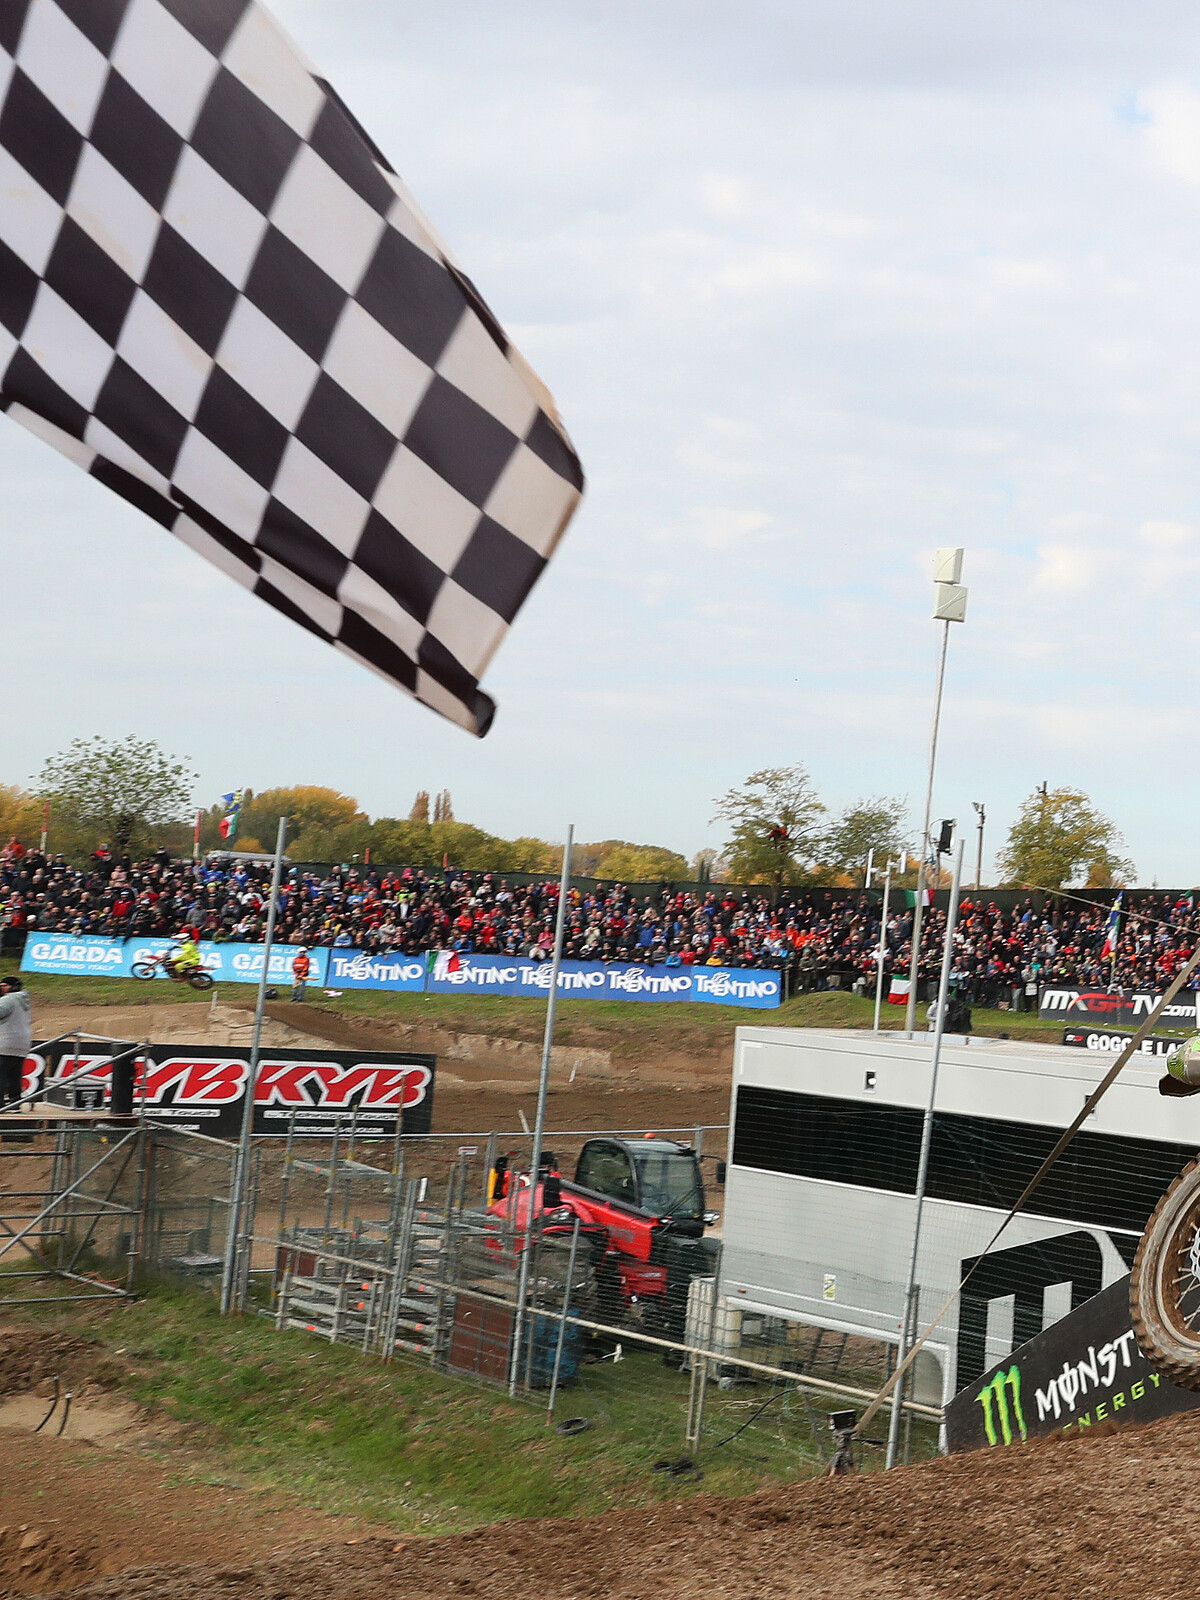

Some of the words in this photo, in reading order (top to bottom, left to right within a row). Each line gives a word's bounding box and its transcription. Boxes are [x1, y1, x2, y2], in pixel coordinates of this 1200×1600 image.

[31, 943, 123, 964] GARDA
[333, 957, 424, 982] TRENTINO
[607, 970, 692, 994] TRENTINO
[694, 974, 778, 999] TRENTINO
[255, 1060, 432, 1108] KYB
[1034, 1330, 1145, 1422] MONST
